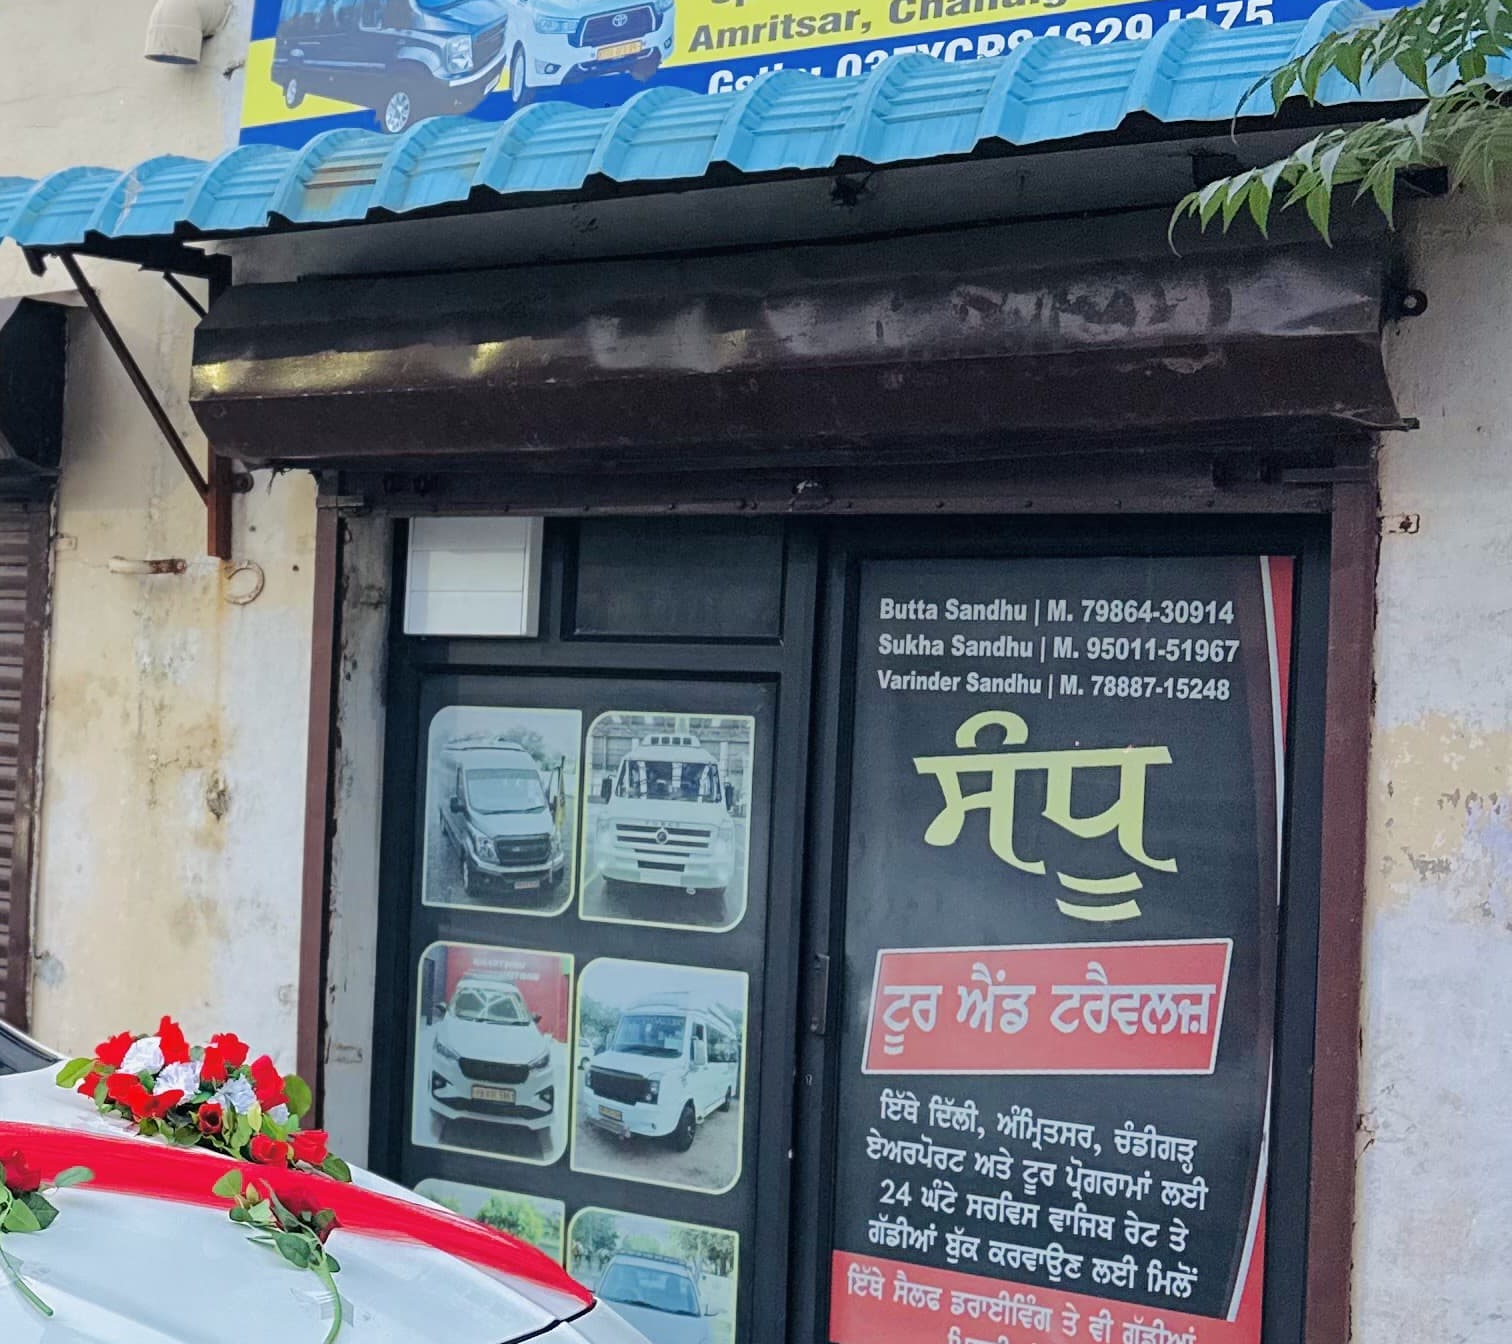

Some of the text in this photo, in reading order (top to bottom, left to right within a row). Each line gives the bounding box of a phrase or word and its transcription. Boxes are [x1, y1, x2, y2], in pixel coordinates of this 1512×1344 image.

[688, 8, 872, 53] Amritsar,
[878, 634, 945, 658] Sukha
[950, 635, 1034, 660] Sandhu
[1053, 637, 1080, 660] M.
[1086, 637, 1240, 664] 95011-51967
[879, 598, 938, 622] Butta
[944, 598, 1028, 624] Sandhu
[1047, 599, 1074, 624] M.
[1082, 599, 1235, 625] 79864-30914
[877, 670, 961, 692] Varinder
[966, 672, 1042, 696] Sandhu
[1059, 674, 1084, 697] M.
[1091, 675, 1230, 701] 78887-15248
[912, 709, 1178, 922] ਸੰਧੂ
[882, 961, 1217, 1055] ਟੂਰ ਐਂਡ ਟਰੈਵਲਜ਼
[866, 1127, 1209, 1210] ਏਅਰਪੋਰਟ ਅਤੇ ਟੂਰ ਪ੍ਰੋਗਰਾਮਾਂ ਲਈ
[880, 1088, 920, 1124] ਇੱਥੇ
[928, 1095, 986, 1139] ਦਿੱਲੀ,
[1114, 1120, 1198, 1175] ਚੰਡੀਗੜ੍ਹ
[868, 1213, 1198, 1298] ਗੱਡੀਆਂ ਬੁੱਕ ਕਰਵਾਉਣ ਲਈ ਮਿਲੋਂ
[879, 1179, 1189, 1252] 24 ਘੰਟੇ ਸਰਵਿਸ ਵਾਜਿਬ ਰੇਟ ਤੇ
[847, 1262, 885, 1300] ਇੱਥੇ
[893, 1270, 943, 1311] ਸੈਲਫ
[950, 1289, 1053, 1333] ਡਰਾਈਵਿੰਗ
[1062, 1301, 1080, 1337] ਤੇ
[1089, 1307, 1113, 1344] ਵੀ
